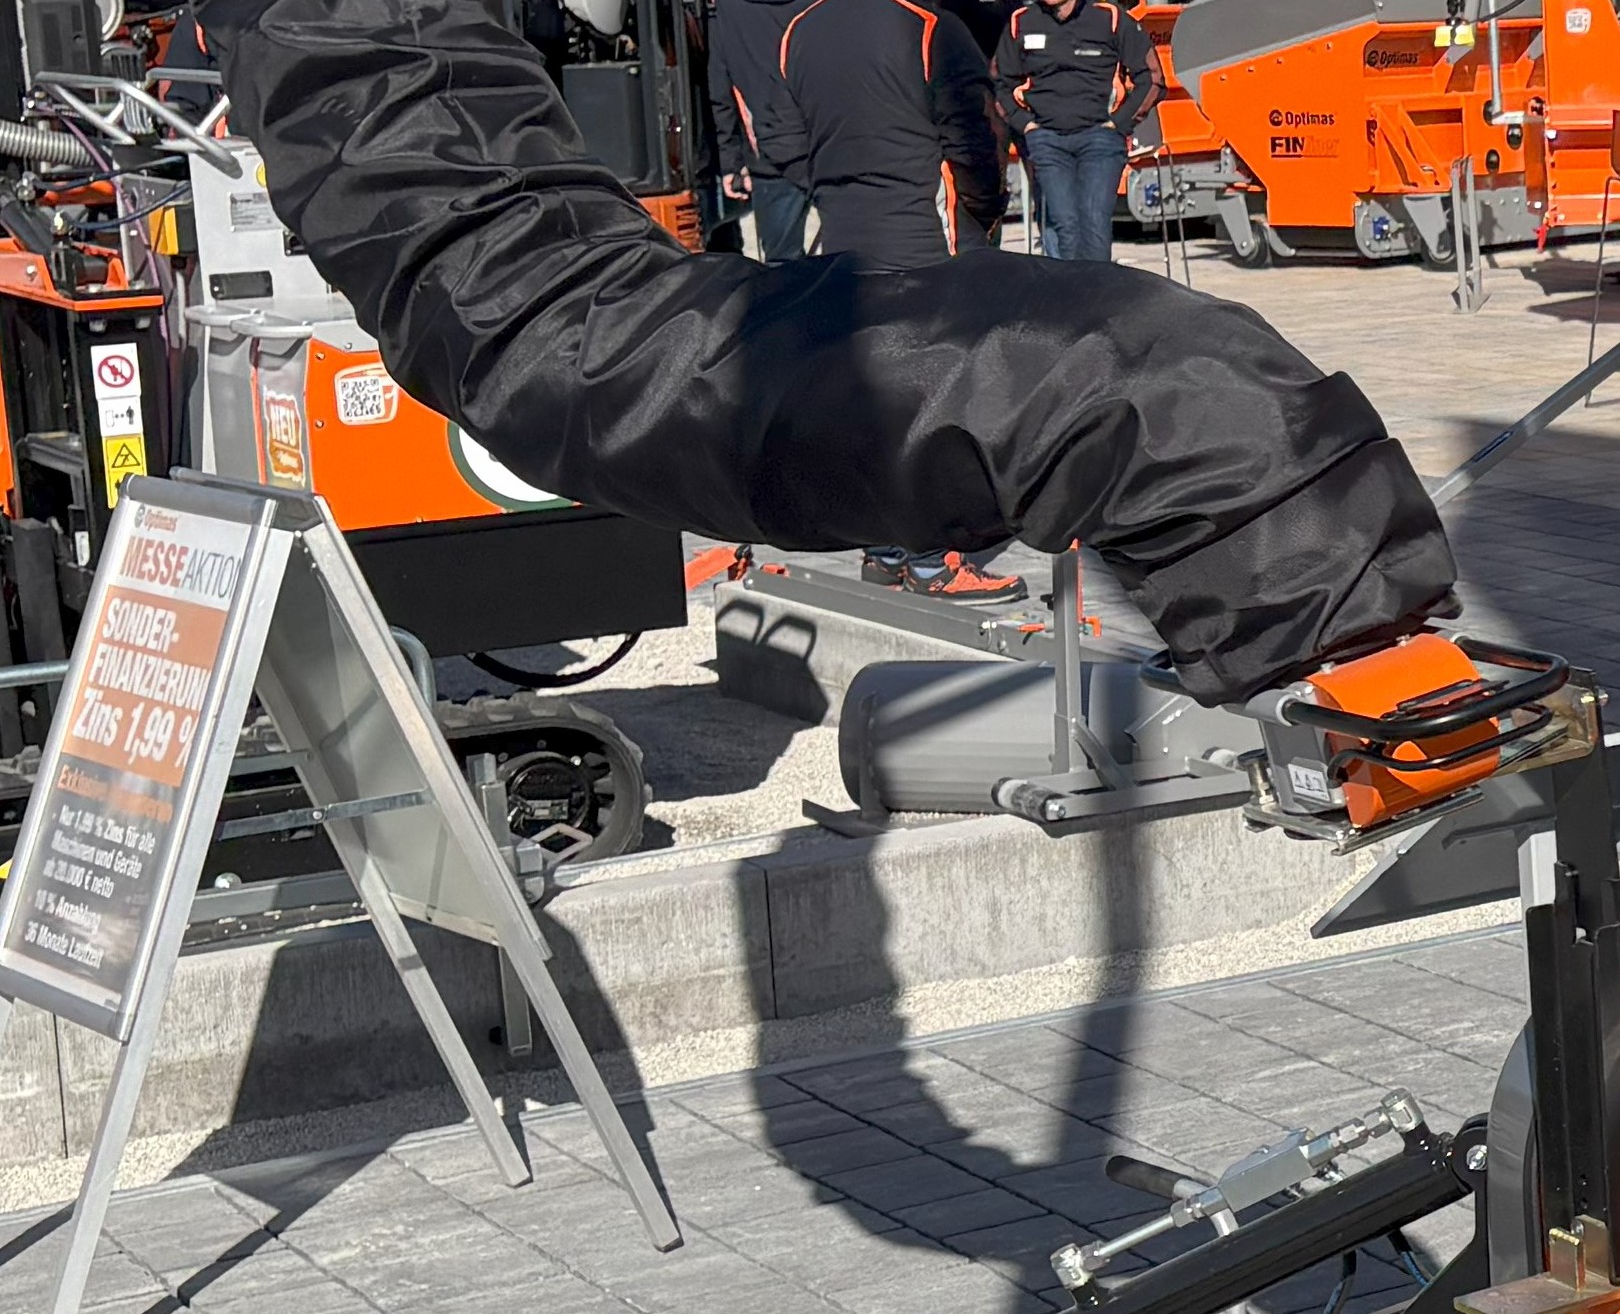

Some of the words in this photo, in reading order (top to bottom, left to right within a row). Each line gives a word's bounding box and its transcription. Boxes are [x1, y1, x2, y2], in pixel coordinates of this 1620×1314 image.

[1285, 111, 1335, 129] Optimas
[102, 597, 179, 653] SONDER-
[72, 688, 123, 747] Zins
[123, 702, 175, 765] 1,99
